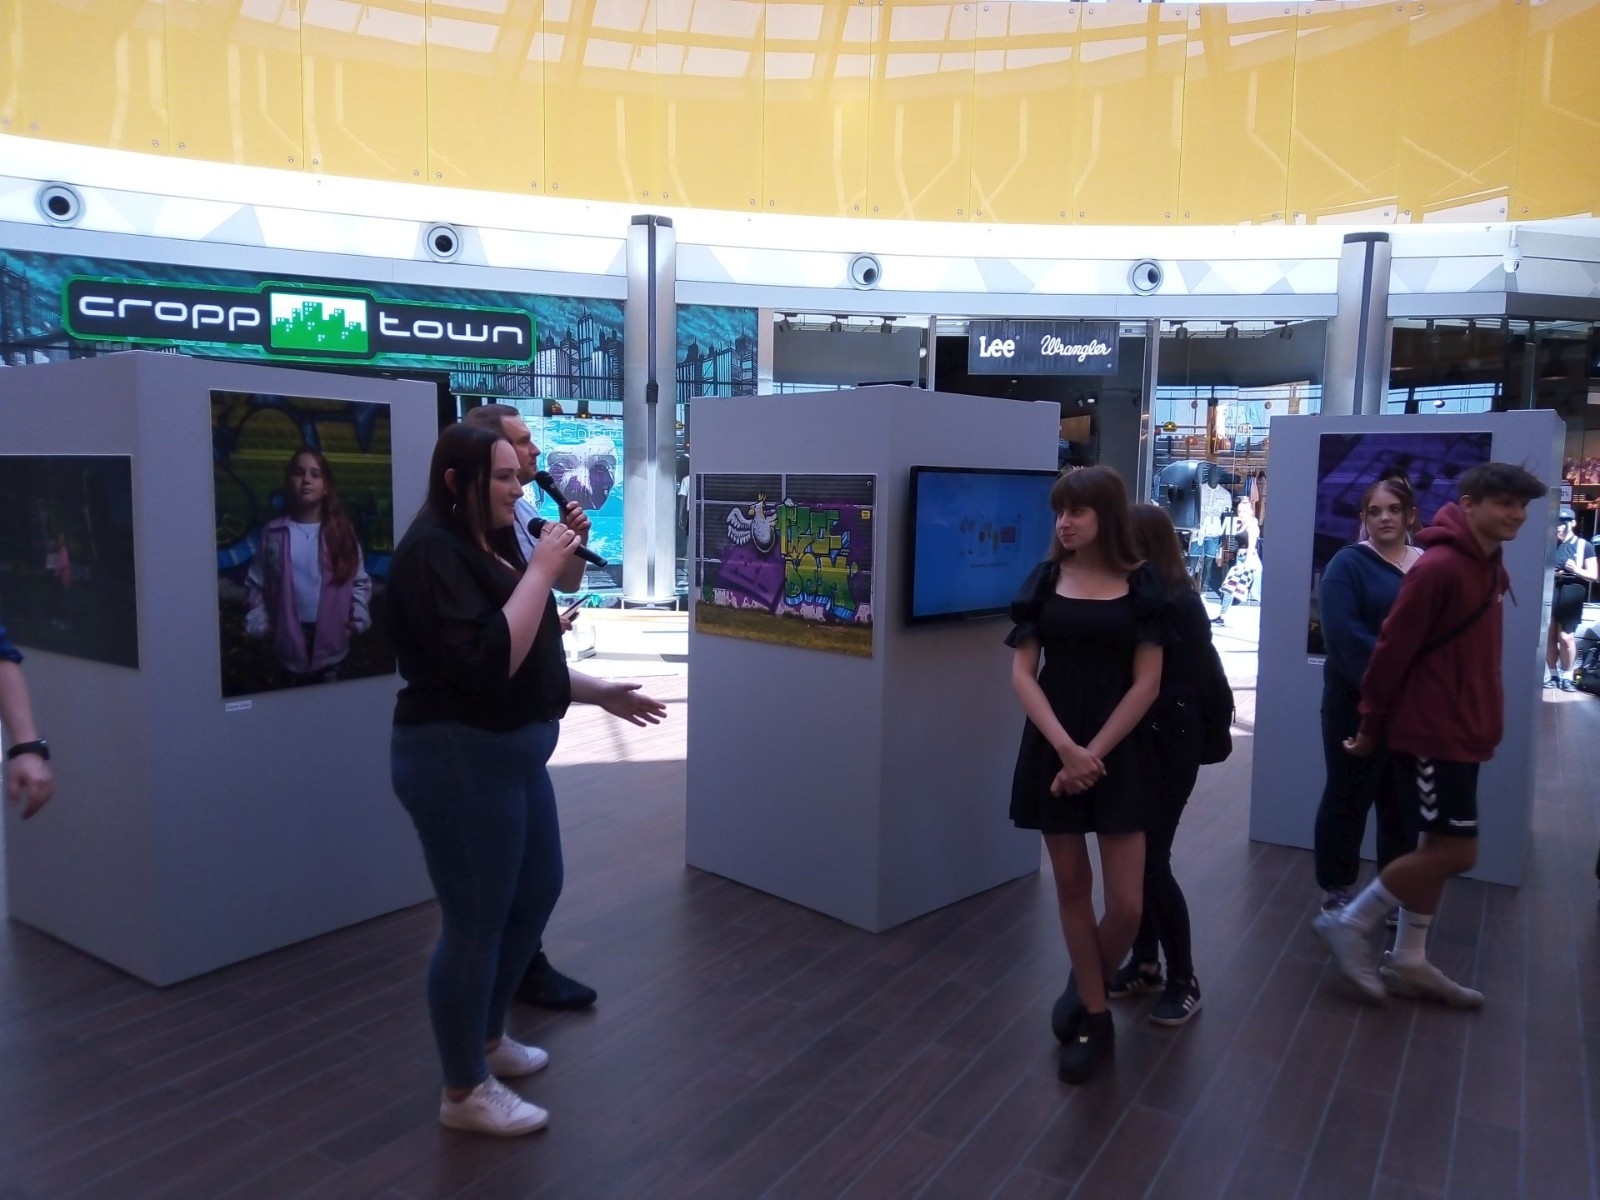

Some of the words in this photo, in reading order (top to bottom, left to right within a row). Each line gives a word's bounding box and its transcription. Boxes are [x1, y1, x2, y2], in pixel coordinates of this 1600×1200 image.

[79, 296, 261, 332] cropp
[379, 311, 523, 345] town
[1040, 334, 1112, 363] Wrangler
